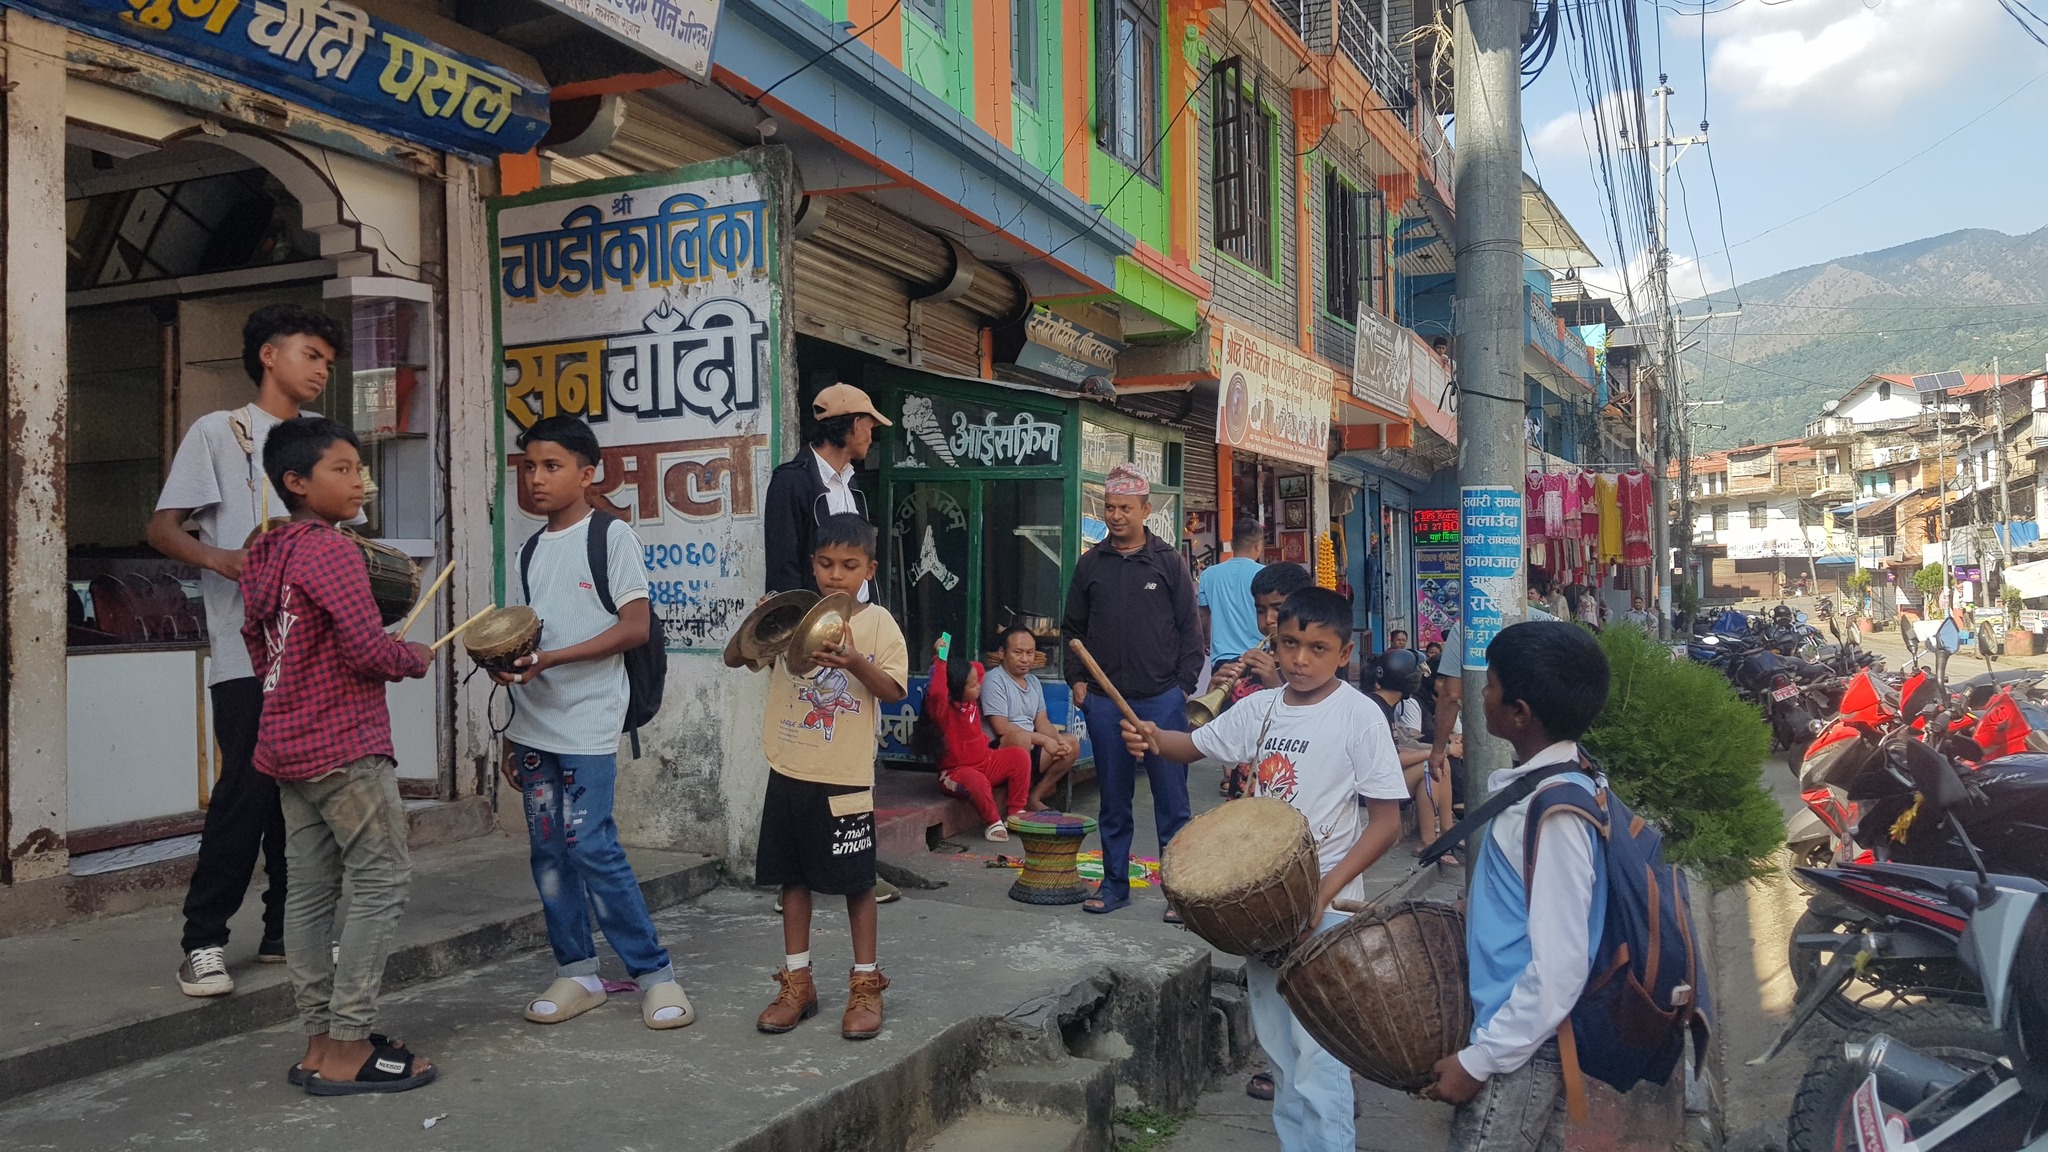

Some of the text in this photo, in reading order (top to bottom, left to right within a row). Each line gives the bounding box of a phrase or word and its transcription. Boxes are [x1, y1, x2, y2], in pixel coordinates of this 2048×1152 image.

[379, 31, 522, 134] पसल
[611, 193, 633, 215] श्री
[500, 193, 769, 303] चण्डीकालिका
[607, 299, 769, 428] चाँदी
[1243, 337, 1271, 379] डिजिटल
[950, 411, 1062, 466] आईसक्रिम
[1463, 494, 1491, 508] सवारी
[1466, 512, 1518, 528] चलाउँदा
[1463, 534, 1485, 545] सवारी
[1465, 556, 1520, 569] कागजात
[1264, 737, 1310, 754] BLEACH
